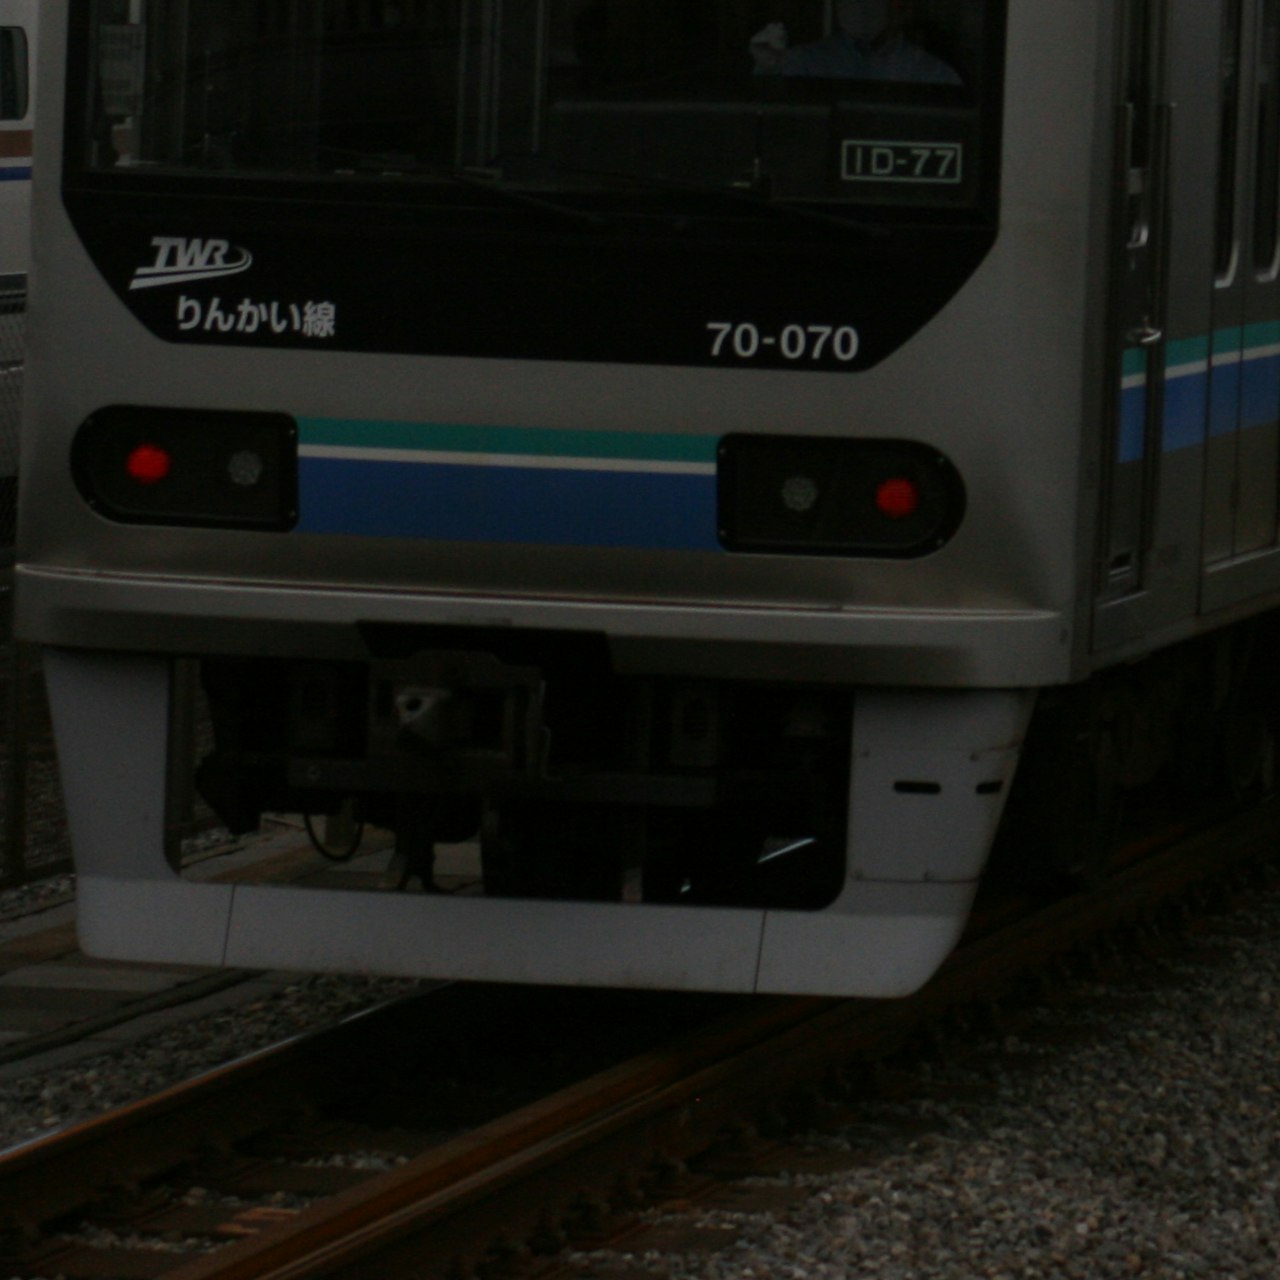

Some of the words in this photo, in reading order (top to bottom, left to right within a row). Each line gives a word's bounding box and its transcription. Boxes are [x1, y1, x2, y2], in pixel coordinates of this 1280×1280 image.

[854, 146, 955, 177] ID-77
[150, 235, 231, 269] TWR
[177, 294, 336, 338] りんかい線
[705, 321, 860, 362] 70-070
